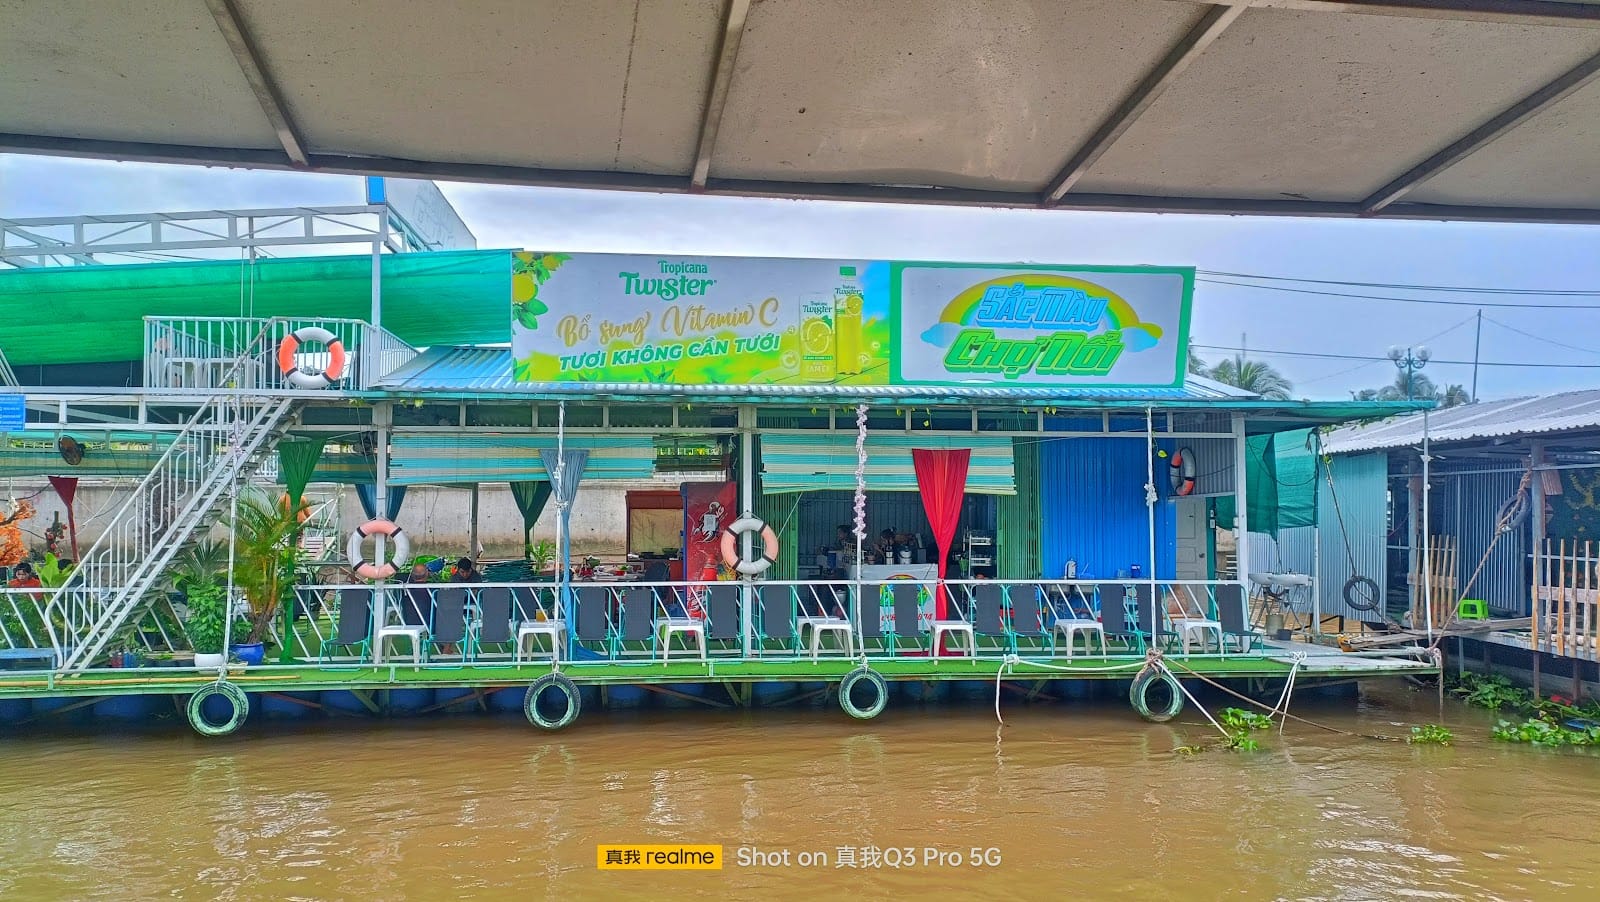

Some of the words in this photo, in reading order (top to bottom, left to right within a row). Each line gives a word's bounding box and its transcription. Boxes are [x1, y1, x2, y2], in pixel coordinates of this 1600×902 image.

[658, 259, 708, 275] Tropicana
[619, 271, 714, 301] Twister
[661, 303, 755, 337] Vitamin
[759, 297, 778, 327] C
[560, 351, 607, 370] TƯƠI
[612, 344, 682, 365] KHÔNG
